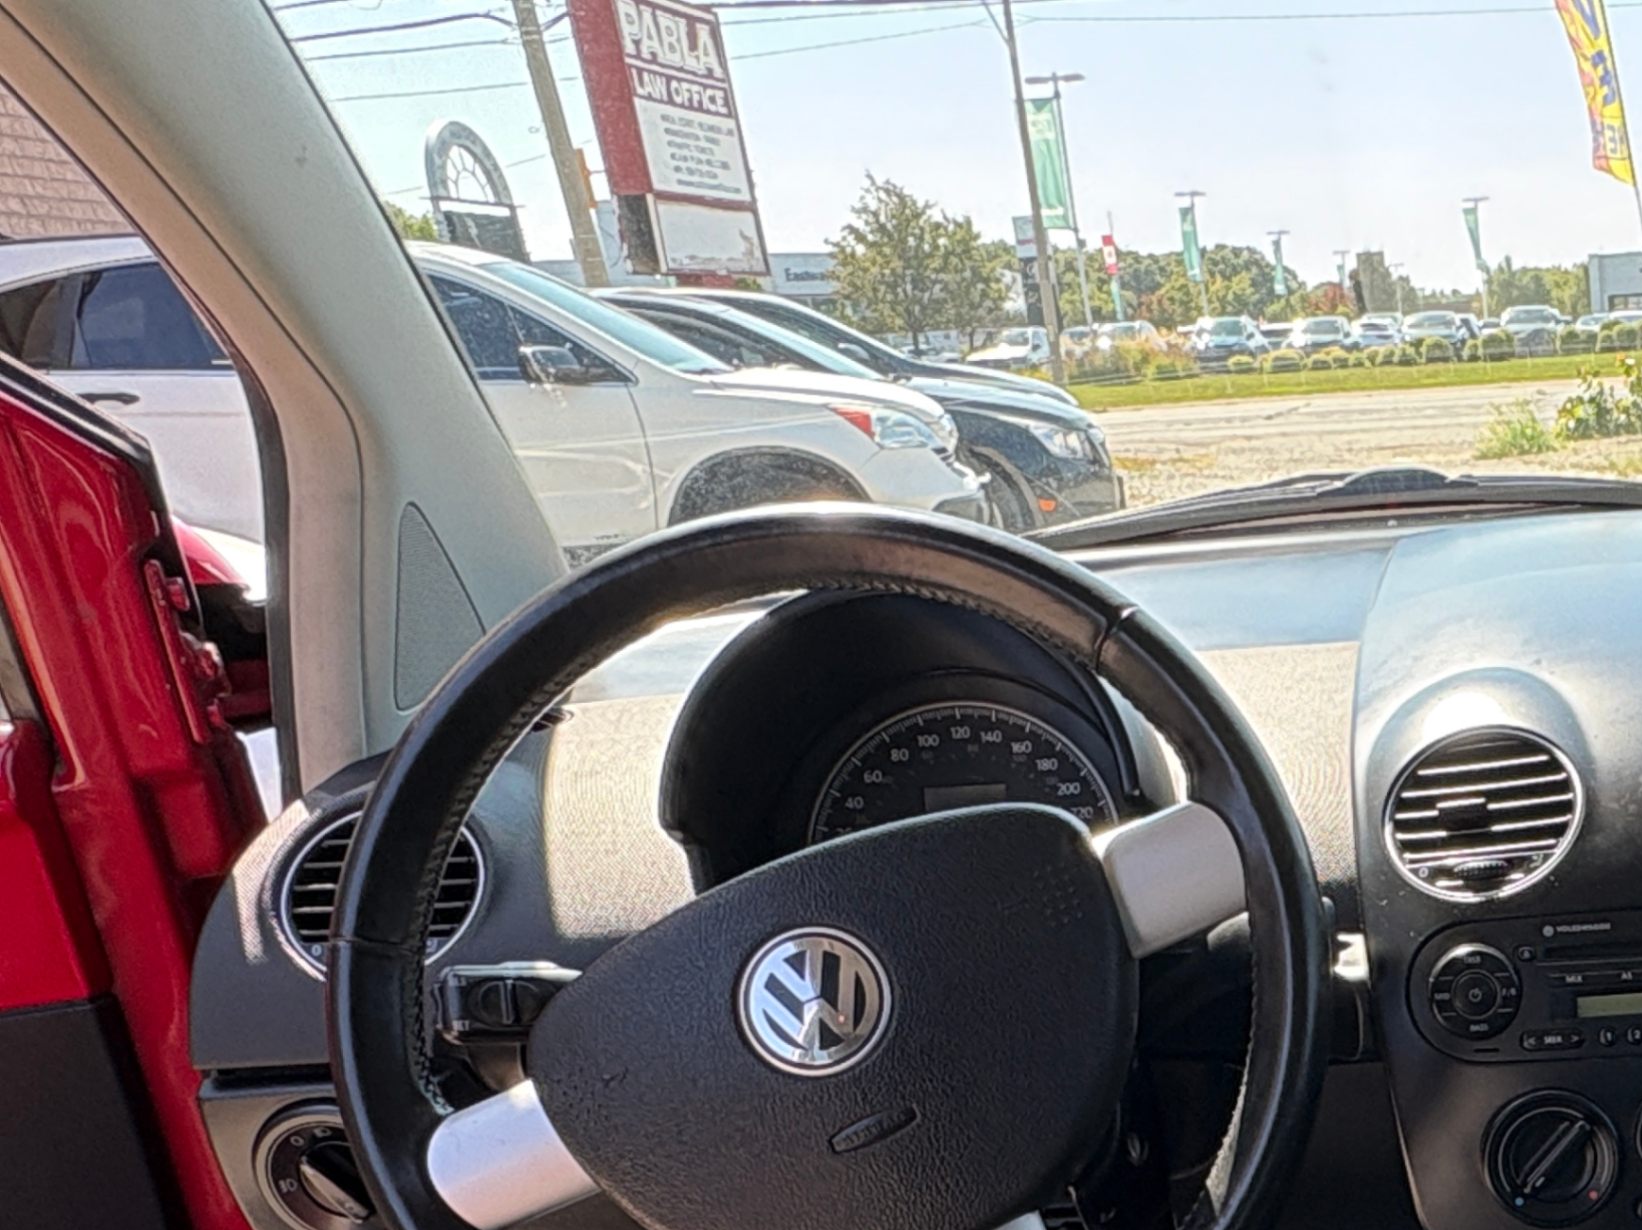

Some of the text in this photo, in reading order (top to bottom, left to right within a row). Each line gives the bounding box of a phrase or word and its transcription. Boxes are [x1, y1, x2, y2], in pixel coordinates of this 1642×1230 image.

[616, 0, 725, 78] PABLA
[631, 67, 729, 114] LAW OFFICE
[950, 726, 971, 740] 120
[980, 730, 1003, 744] 140
[917, 734, 940, 748] 100
[1010, 740, 1033, 754] 160
[889, 748, 910, 762] 80
[1035, 758, 1059, 771] 180
[863, 770, 883, 783] 60
[1055, 782, 1081, 796] 200
[844, 796, 865, 810] 40
[744, 931, 887, 1072] VW
